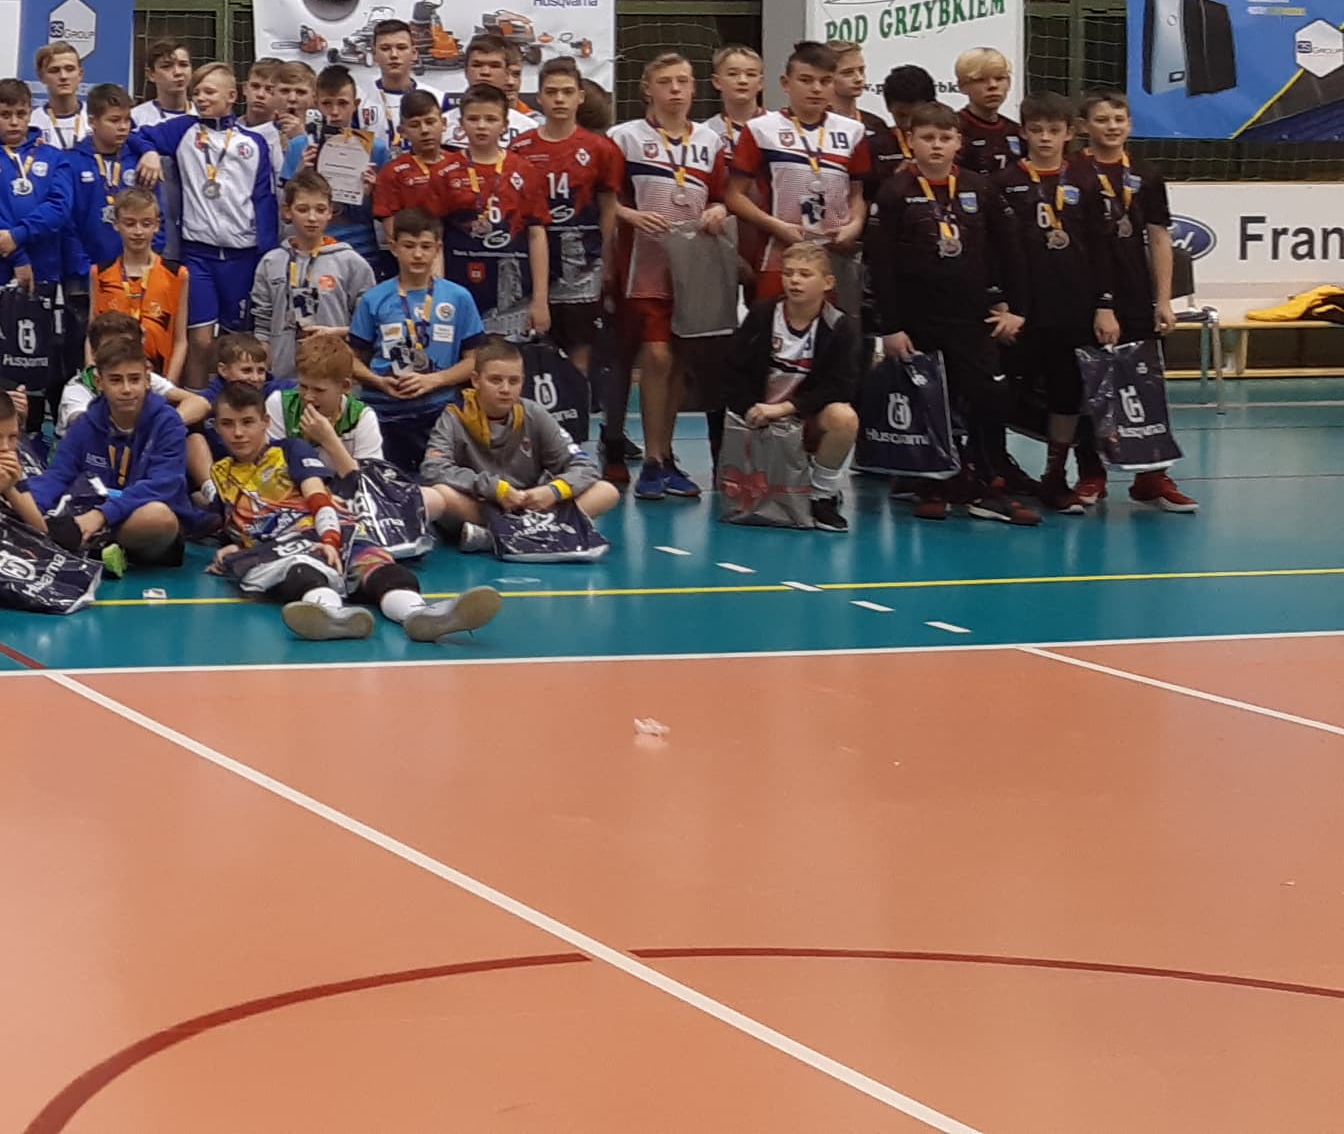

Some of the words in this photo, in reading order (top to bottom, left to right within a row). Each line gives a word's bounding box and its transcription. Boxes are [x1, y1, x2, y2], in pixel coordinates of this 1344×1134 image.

[825, 14, 869, 45] POD
[829, 131, 850, 150] 19
[692, 143, 709, 166] 14
[994, 154, 1006, 169] 7
[546, 171, 571, 200] 14
